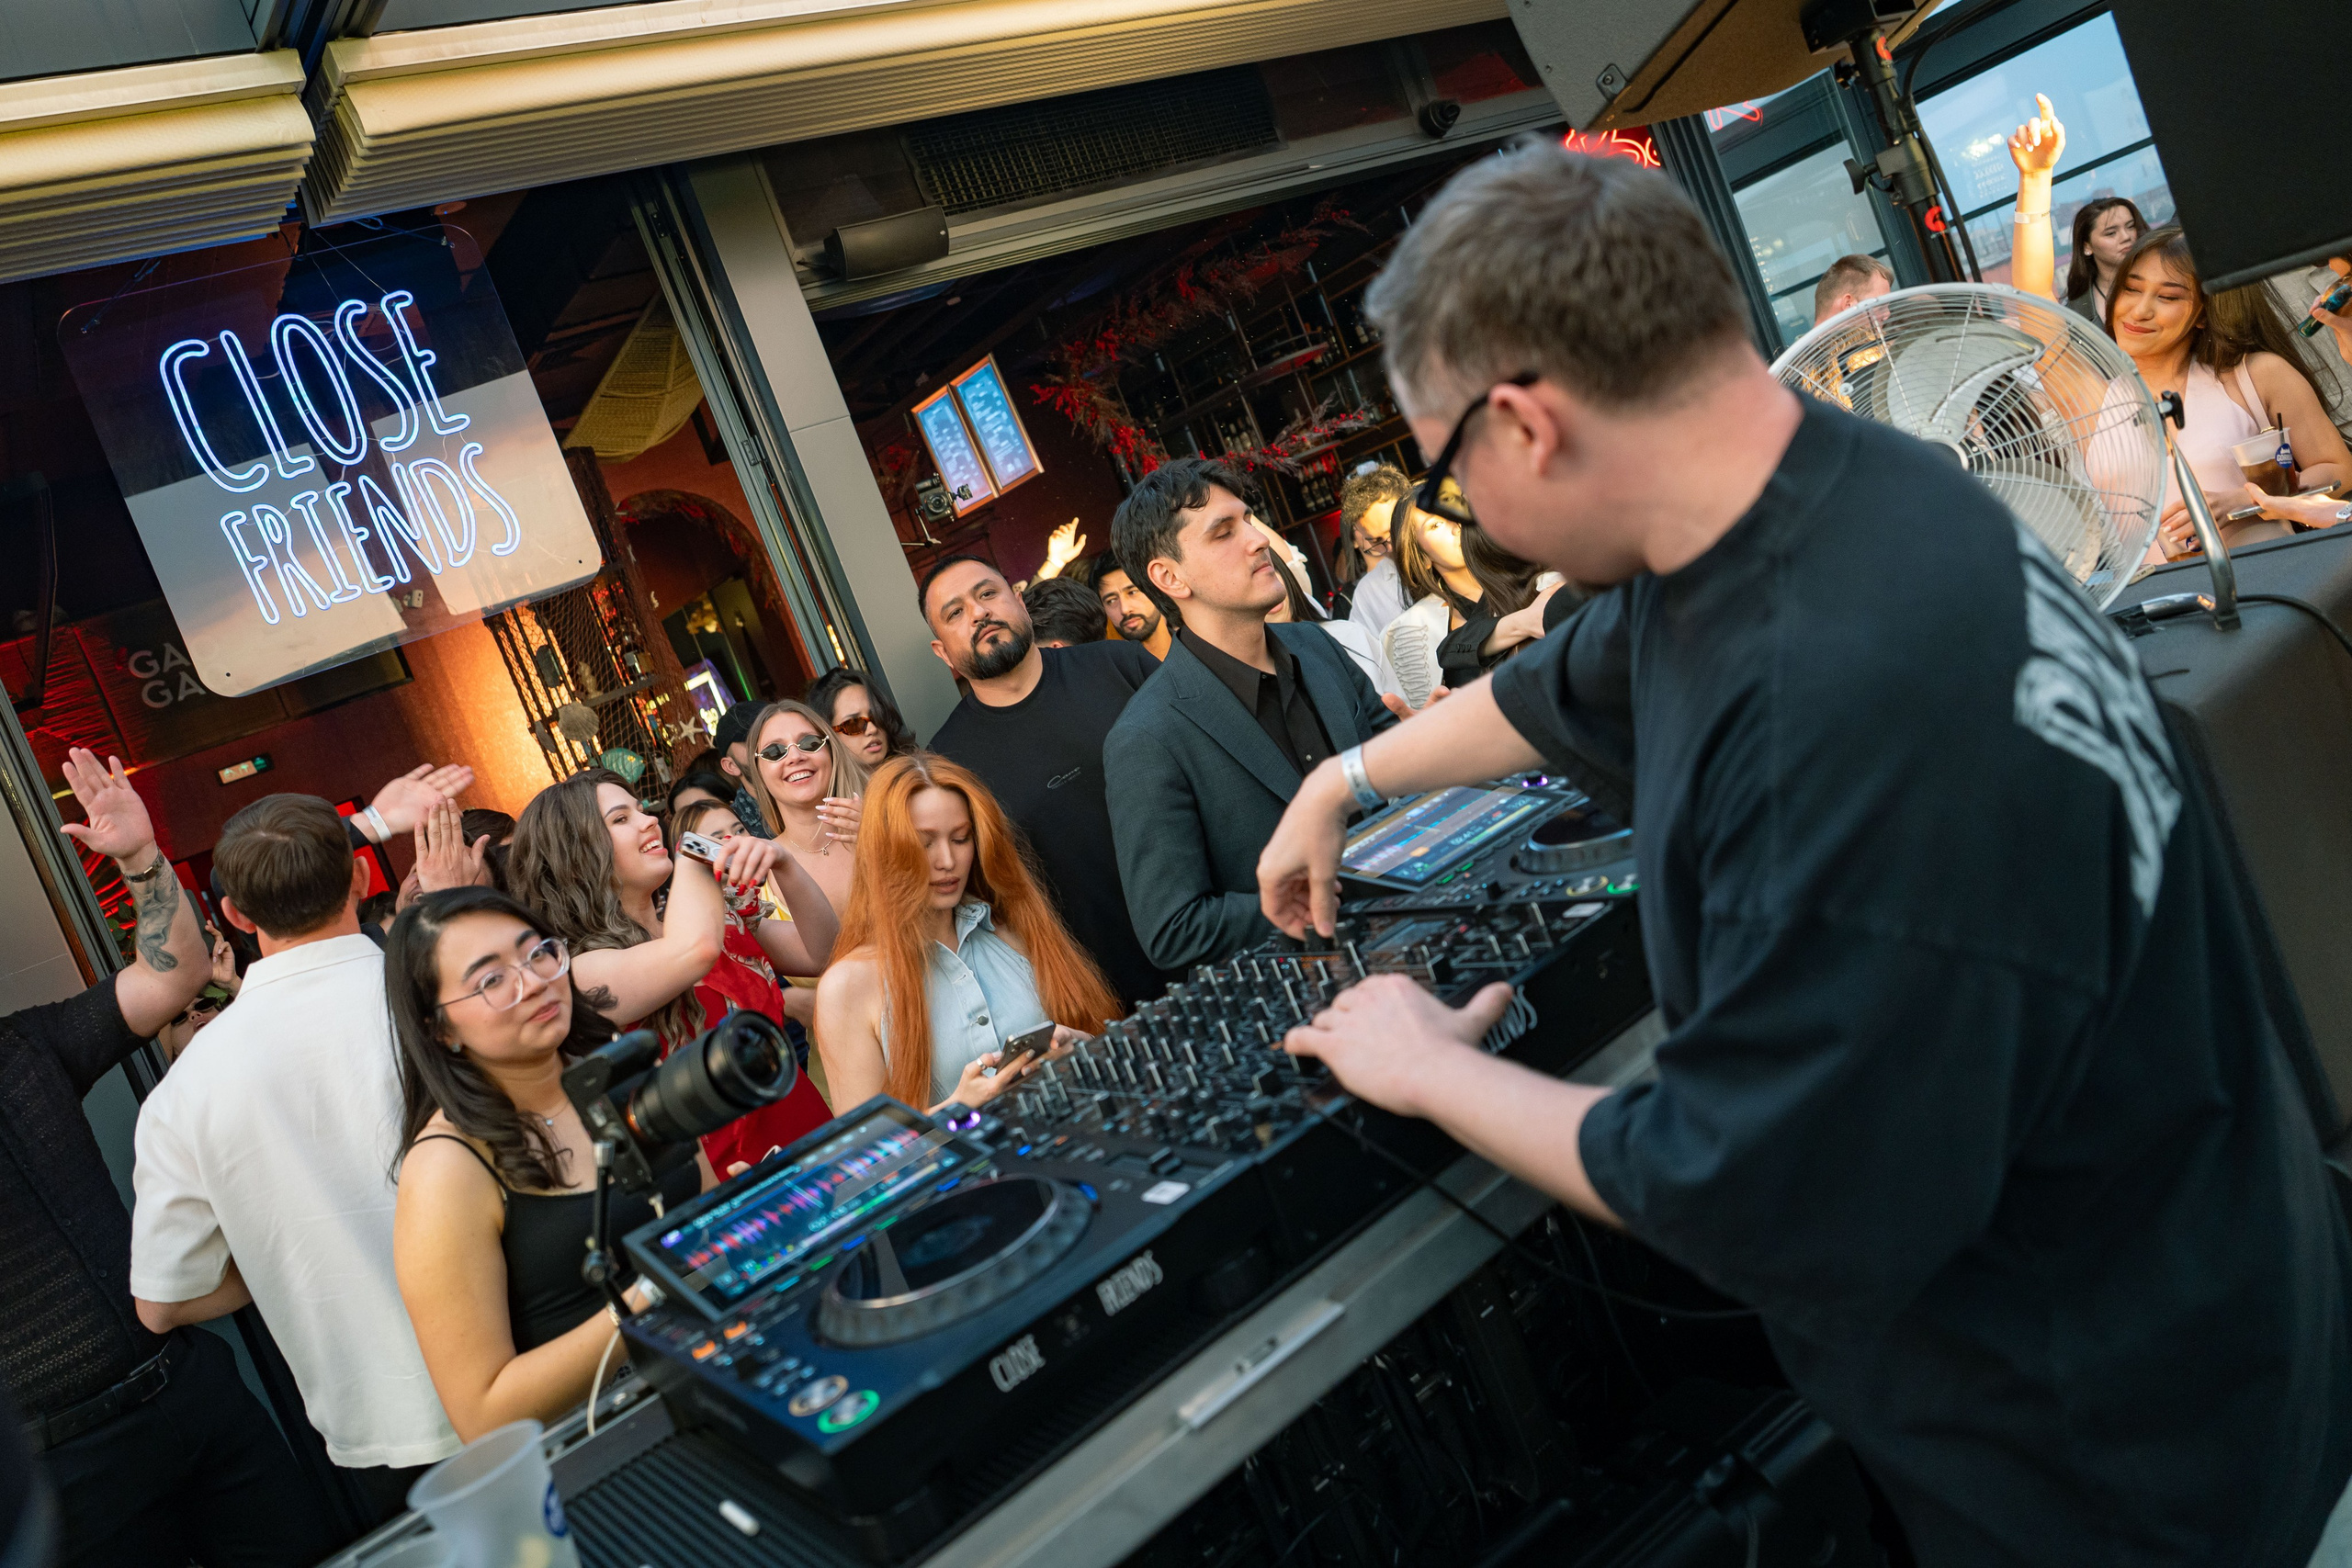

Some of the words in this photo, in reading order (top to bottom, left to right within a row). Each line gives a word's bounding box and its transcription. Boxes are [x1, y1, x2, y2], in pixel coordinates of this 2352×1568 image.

[159, 289, 471, 493] CLOSE
[220, 442, 522, 626] FRIENDS
[129, 642, 191, 679] GA
[141, 671, 207, 709] GA
